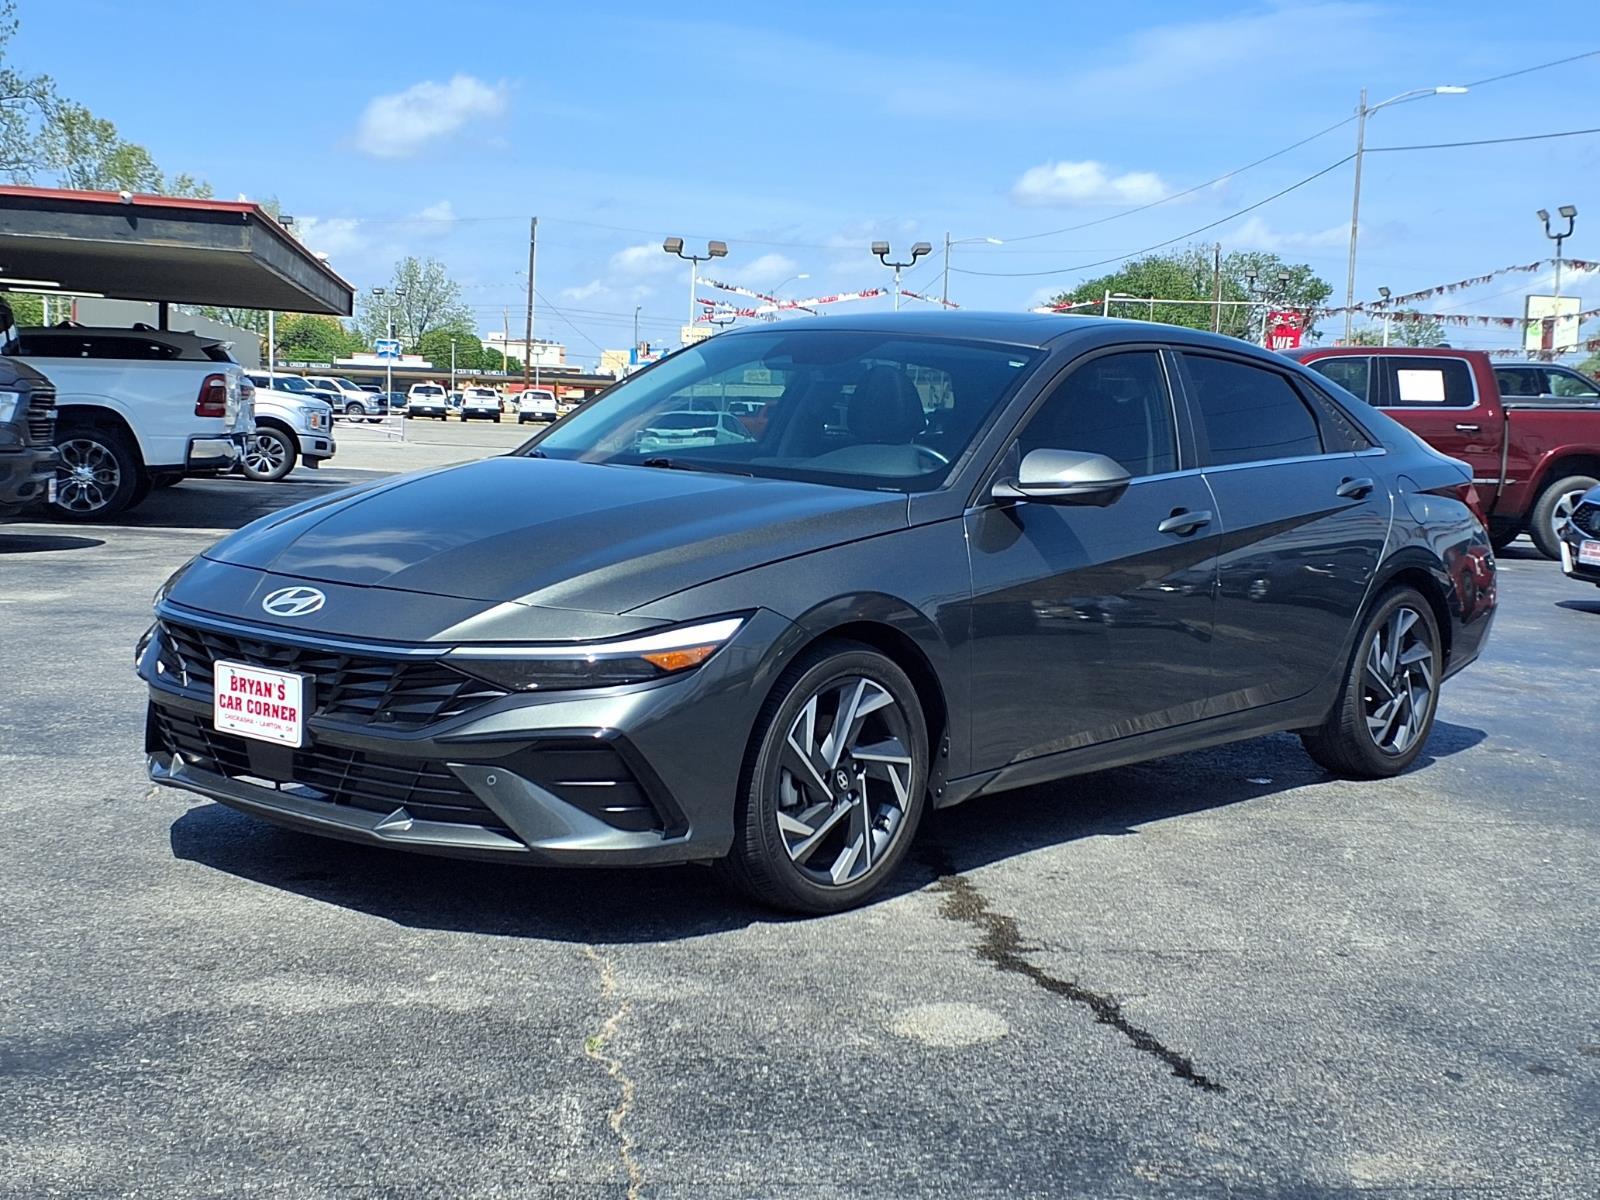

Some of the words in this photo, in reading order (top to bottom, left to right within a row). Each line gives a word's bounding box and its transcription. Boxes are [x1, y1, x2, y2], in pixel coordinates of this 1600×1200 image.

[1272, 335, 1294, 349] WE
[230, 675, 286, 701] BRYAN'S
[219, 694, 243, 711] CAR
[247, 699, 297, 722] CORNER
